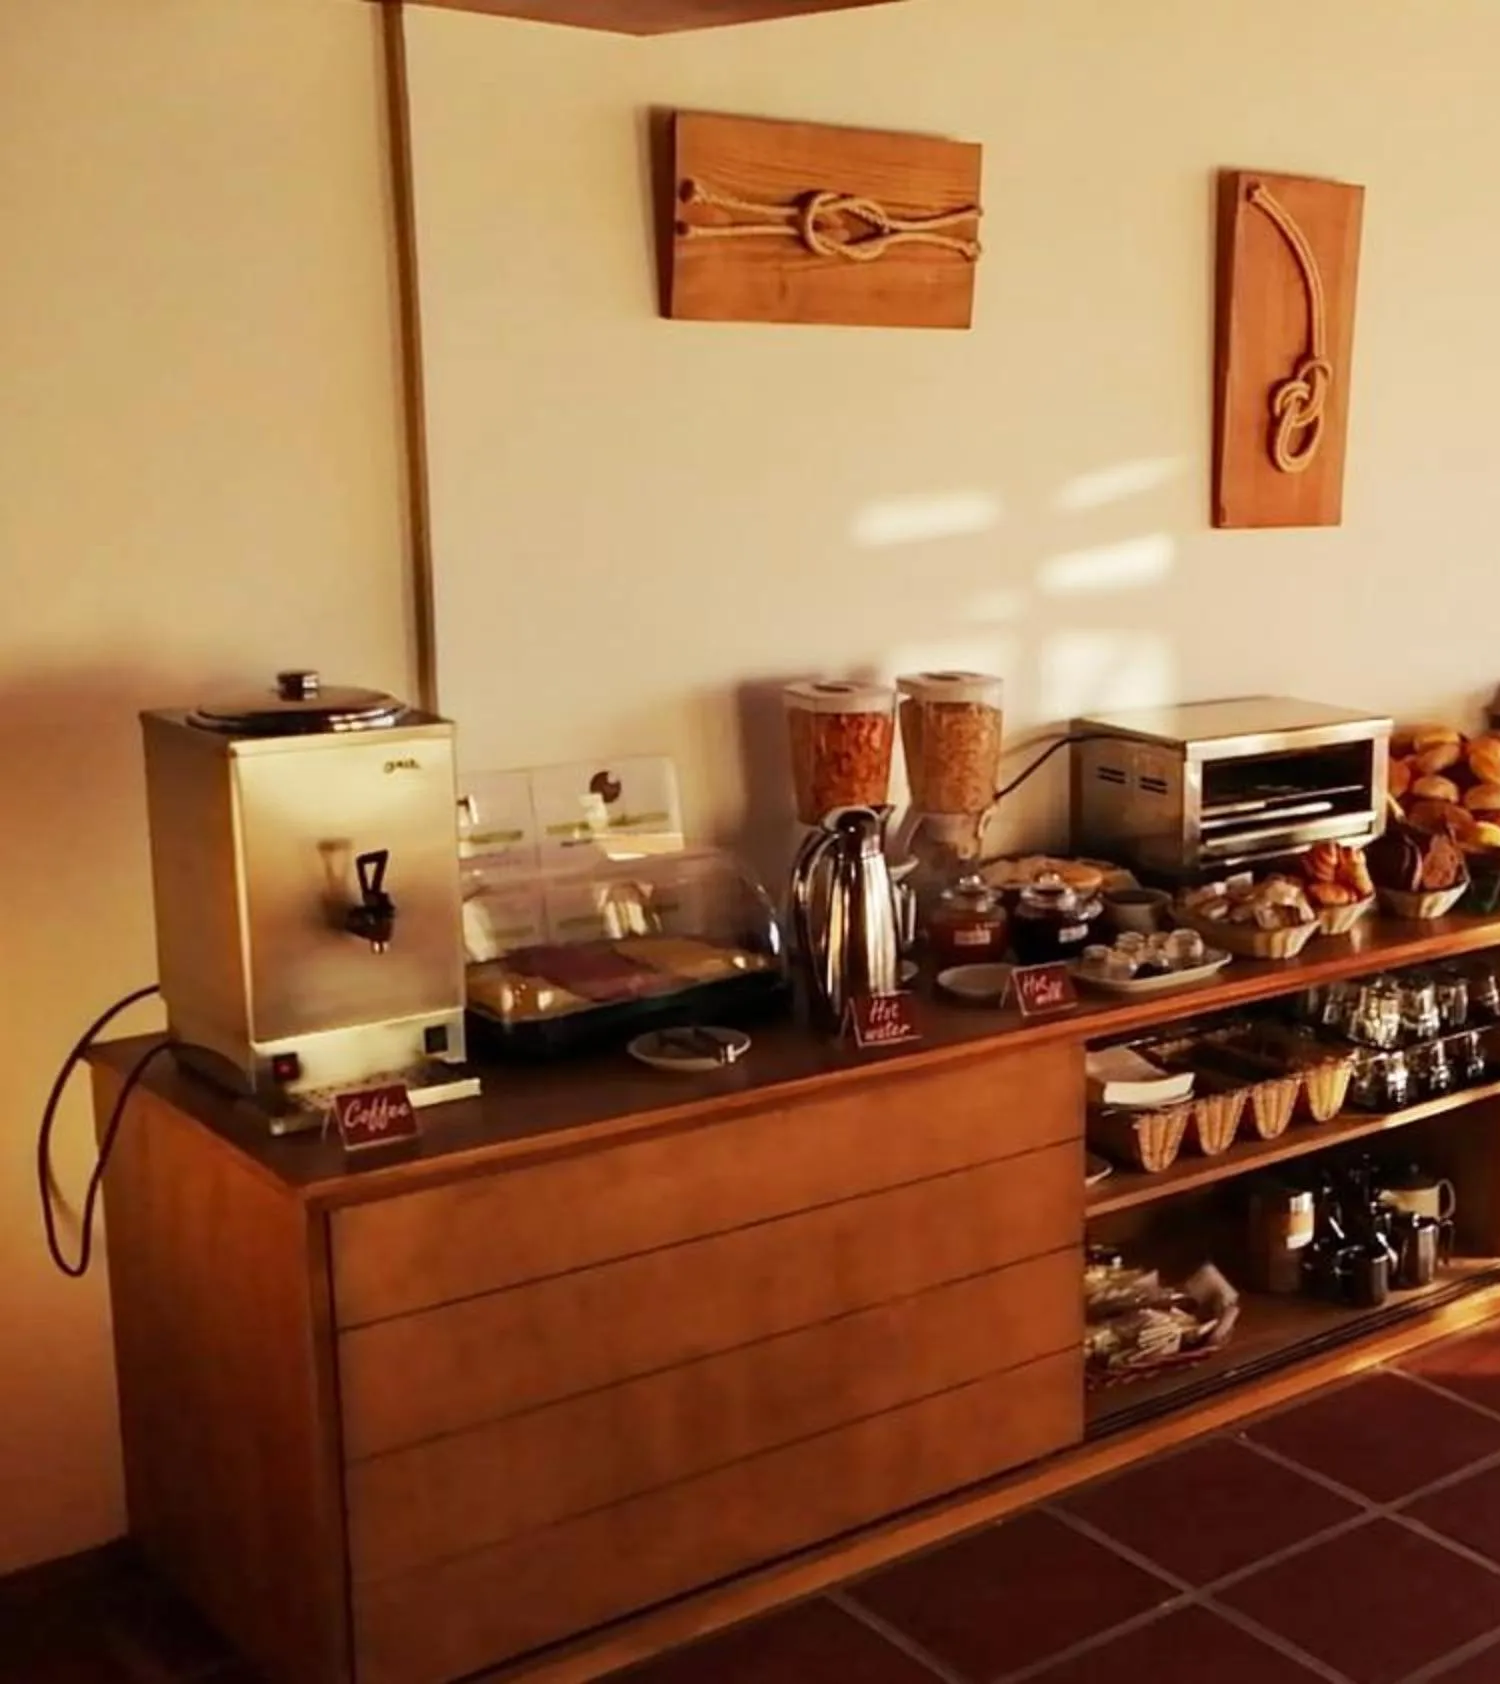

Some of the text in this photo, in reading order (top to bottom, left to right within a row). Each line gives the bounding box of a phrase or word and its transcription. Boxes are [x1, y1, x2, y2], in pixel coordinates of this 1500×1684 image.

[870, 999, 900, 1023] Hot
[864, 1021, 911, 1040] water
[344, 1097, 409, 1132] Coffee
